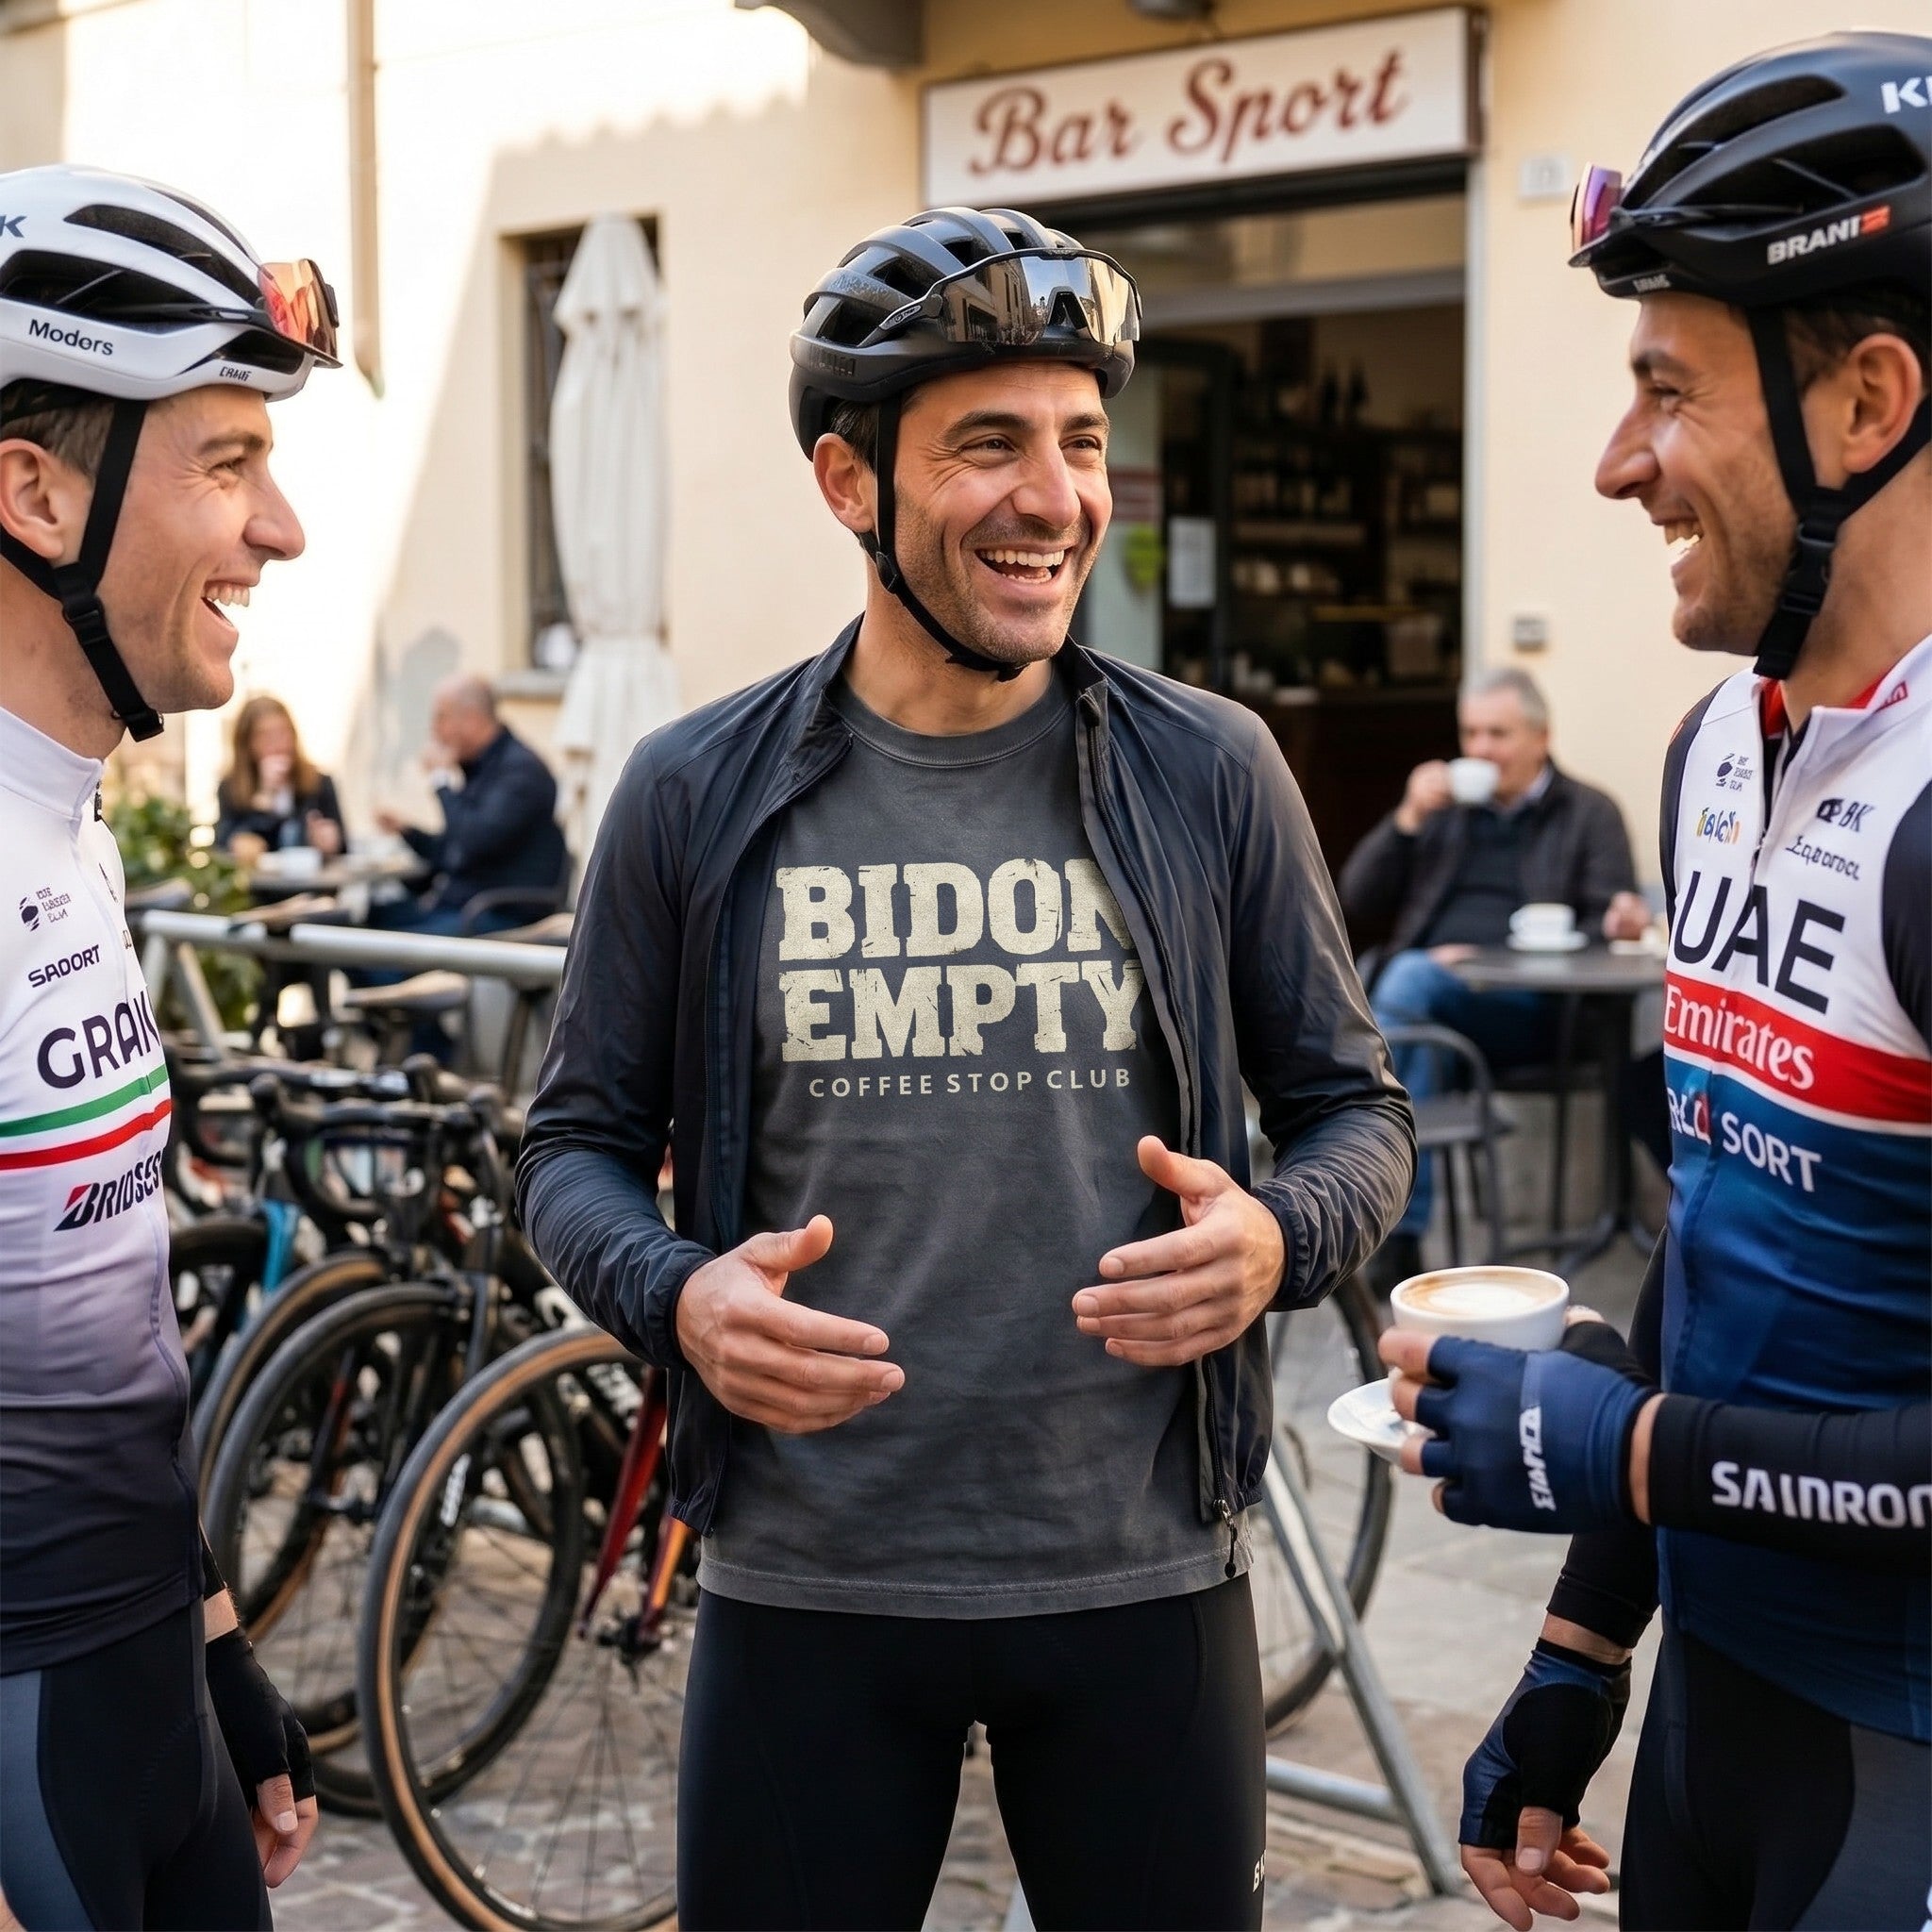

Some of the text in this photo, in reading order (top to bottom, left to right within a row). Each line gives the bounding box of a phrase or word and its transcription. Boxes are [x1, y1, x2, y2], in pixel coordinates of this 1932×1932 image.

[970, 46, 1407, 177] Bar Sport
[27, 944, 100, 989] SADORT
[1674, 870, 1846, 1016] UAE
[778, 959, 1146, 1062] EMPTY
[1664, 984, 1815, 1091] Emirates
[808, 1068, 1131, 1098] COFFEE STOP CLUB
[1721, 1110, 1823, 1192] SORT
